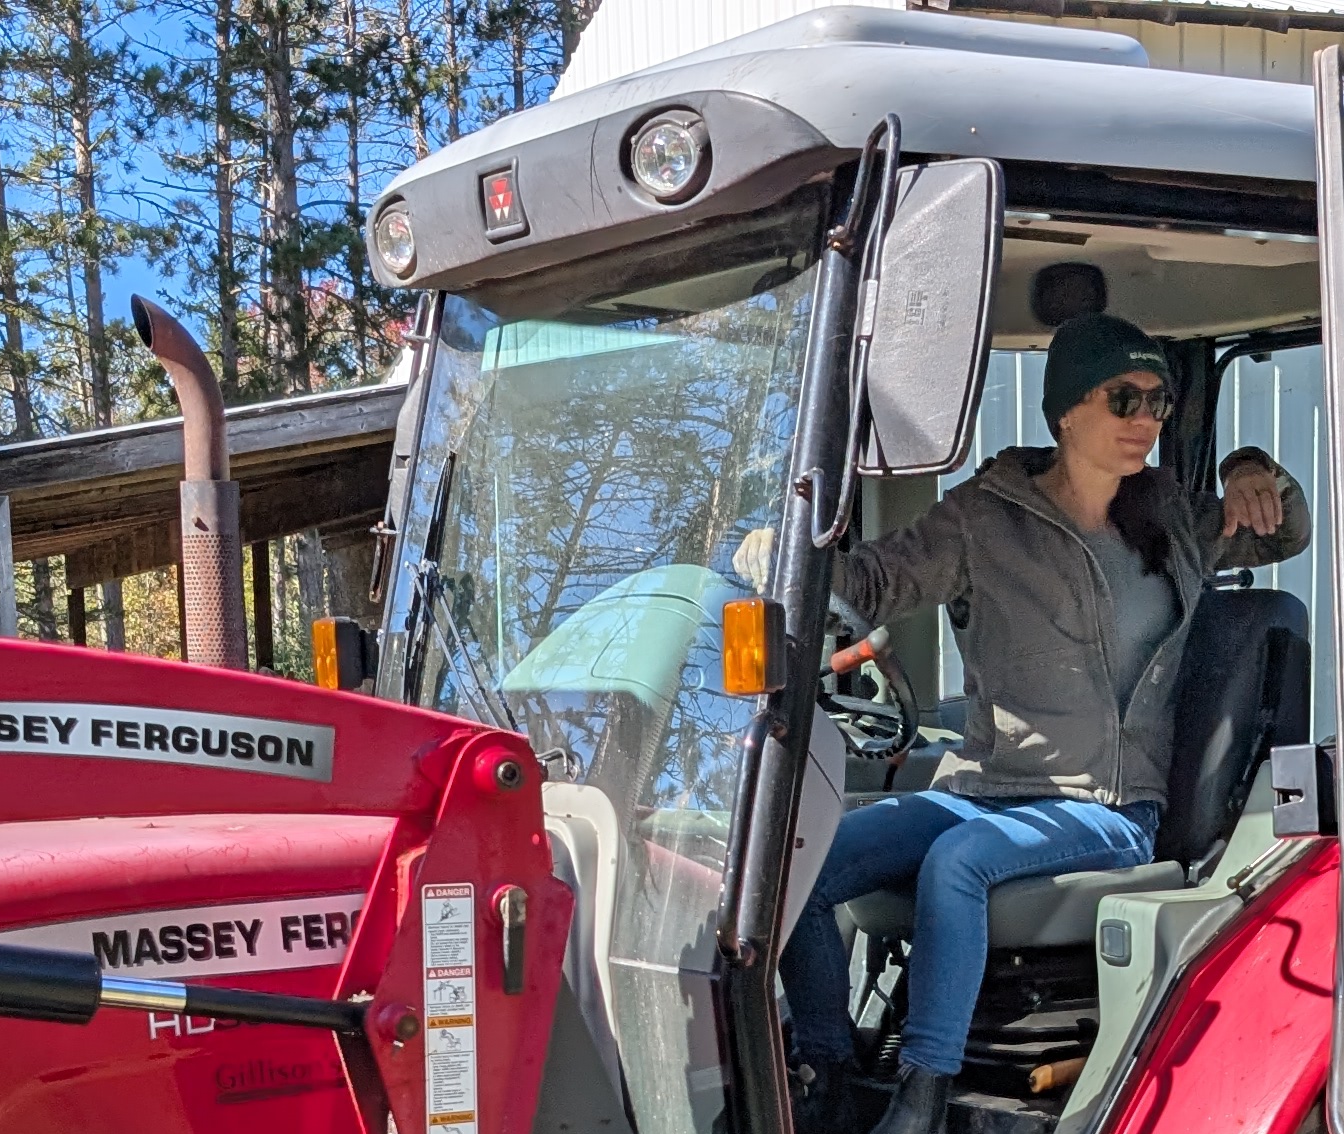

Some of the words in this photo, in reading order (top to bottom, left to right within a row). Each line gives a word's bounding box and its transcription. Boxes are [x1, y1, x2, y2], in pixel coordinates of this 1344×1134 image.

[90, 718, 315, 767] FERGUSON
[436, 886, 470, 897] DANGER
[92, 918, 264, 969] MASSEY
[280, 909, 362, 953] FER
[437, 966, 471, 977] DANGER
[437, 1016, 471, 1026] WARNING
[440, 1113, 474, 1123] WARNING
